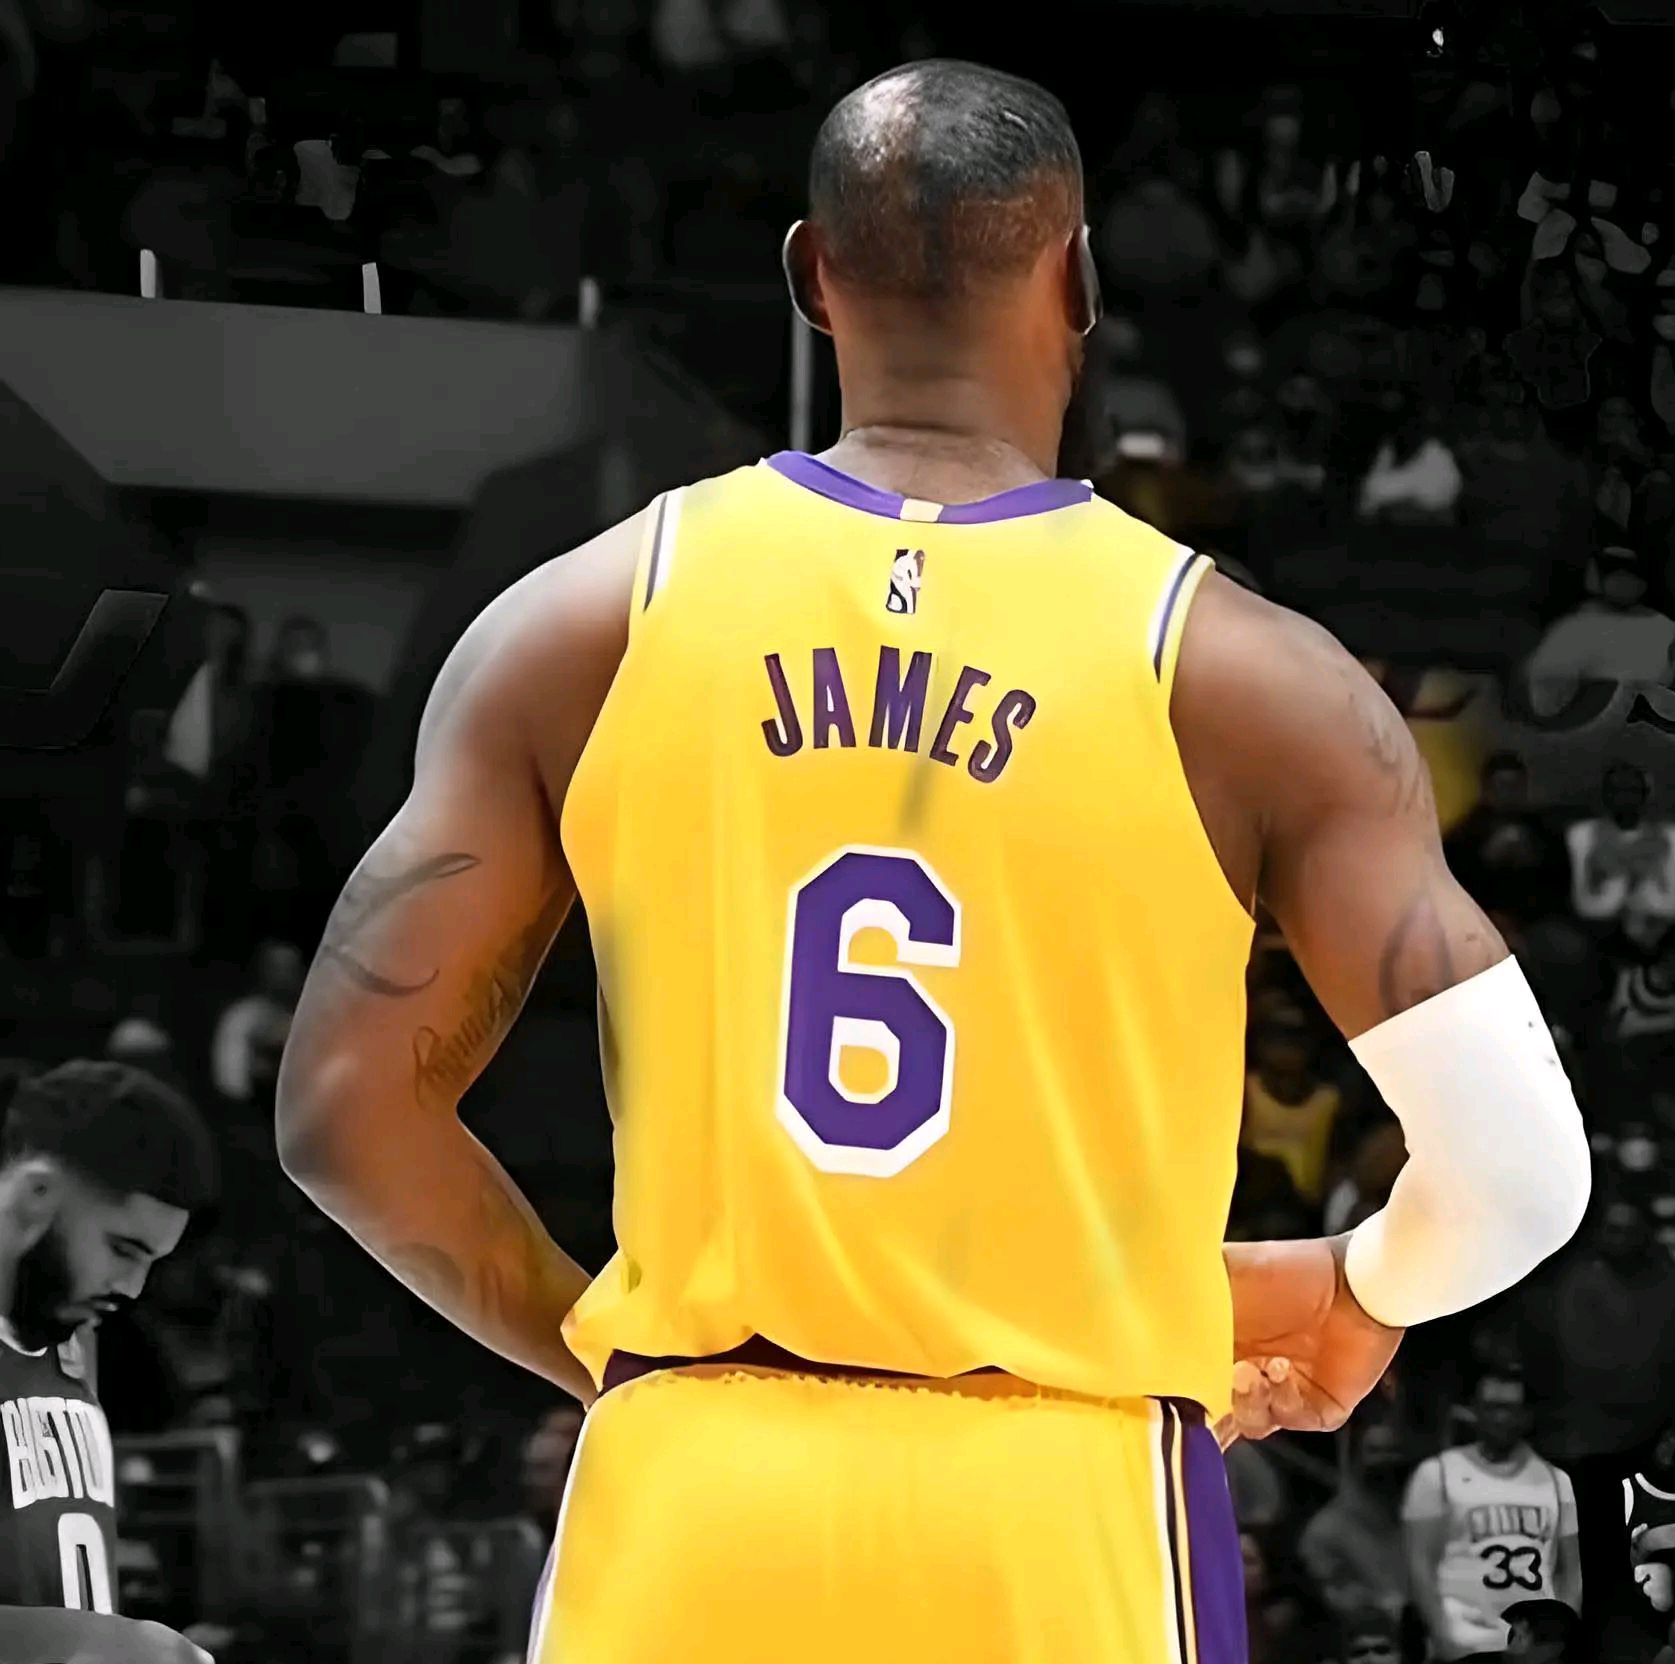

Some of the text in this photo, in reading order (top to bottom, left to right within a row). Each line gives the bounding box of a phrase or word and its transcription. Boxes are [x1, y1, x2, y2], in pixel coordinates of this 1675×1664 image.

[761, 645, 1037, 783] JAMES
[778, 846, 960, 1177] 6
[1480, 1544, 1543, 1591] 33
